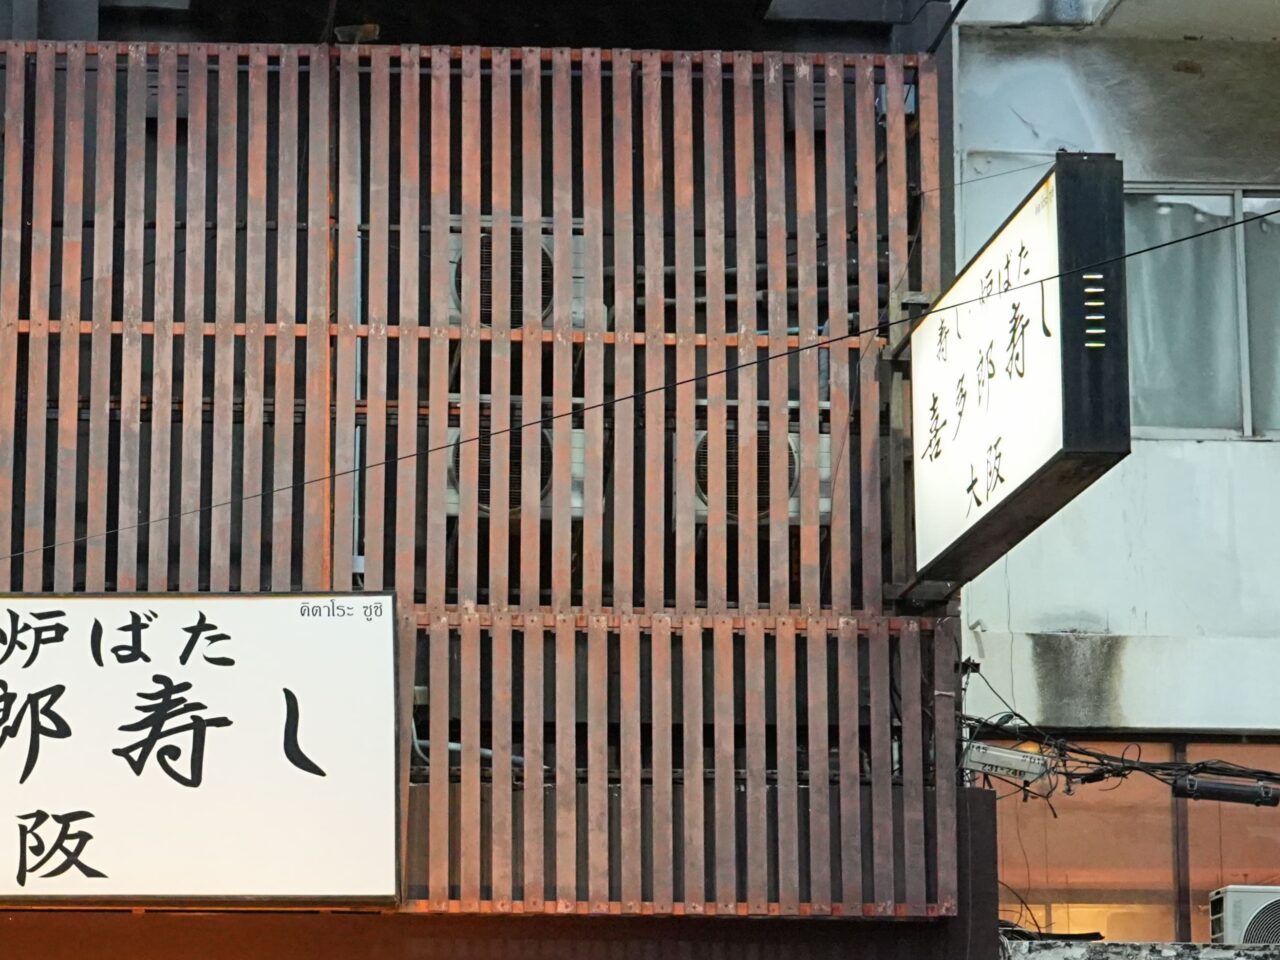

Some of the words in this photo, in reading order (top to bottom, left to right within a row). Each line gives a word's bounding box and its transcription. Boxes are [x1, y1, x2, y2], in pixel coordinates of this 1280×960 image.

[921, 280, 1052, 463] 喜多郎寿し
[966, 437, 1006, 518] 大阪
[300, 599, 354, 617] คิตาโระ
[362, 602, 383, 621] ซูชิ
